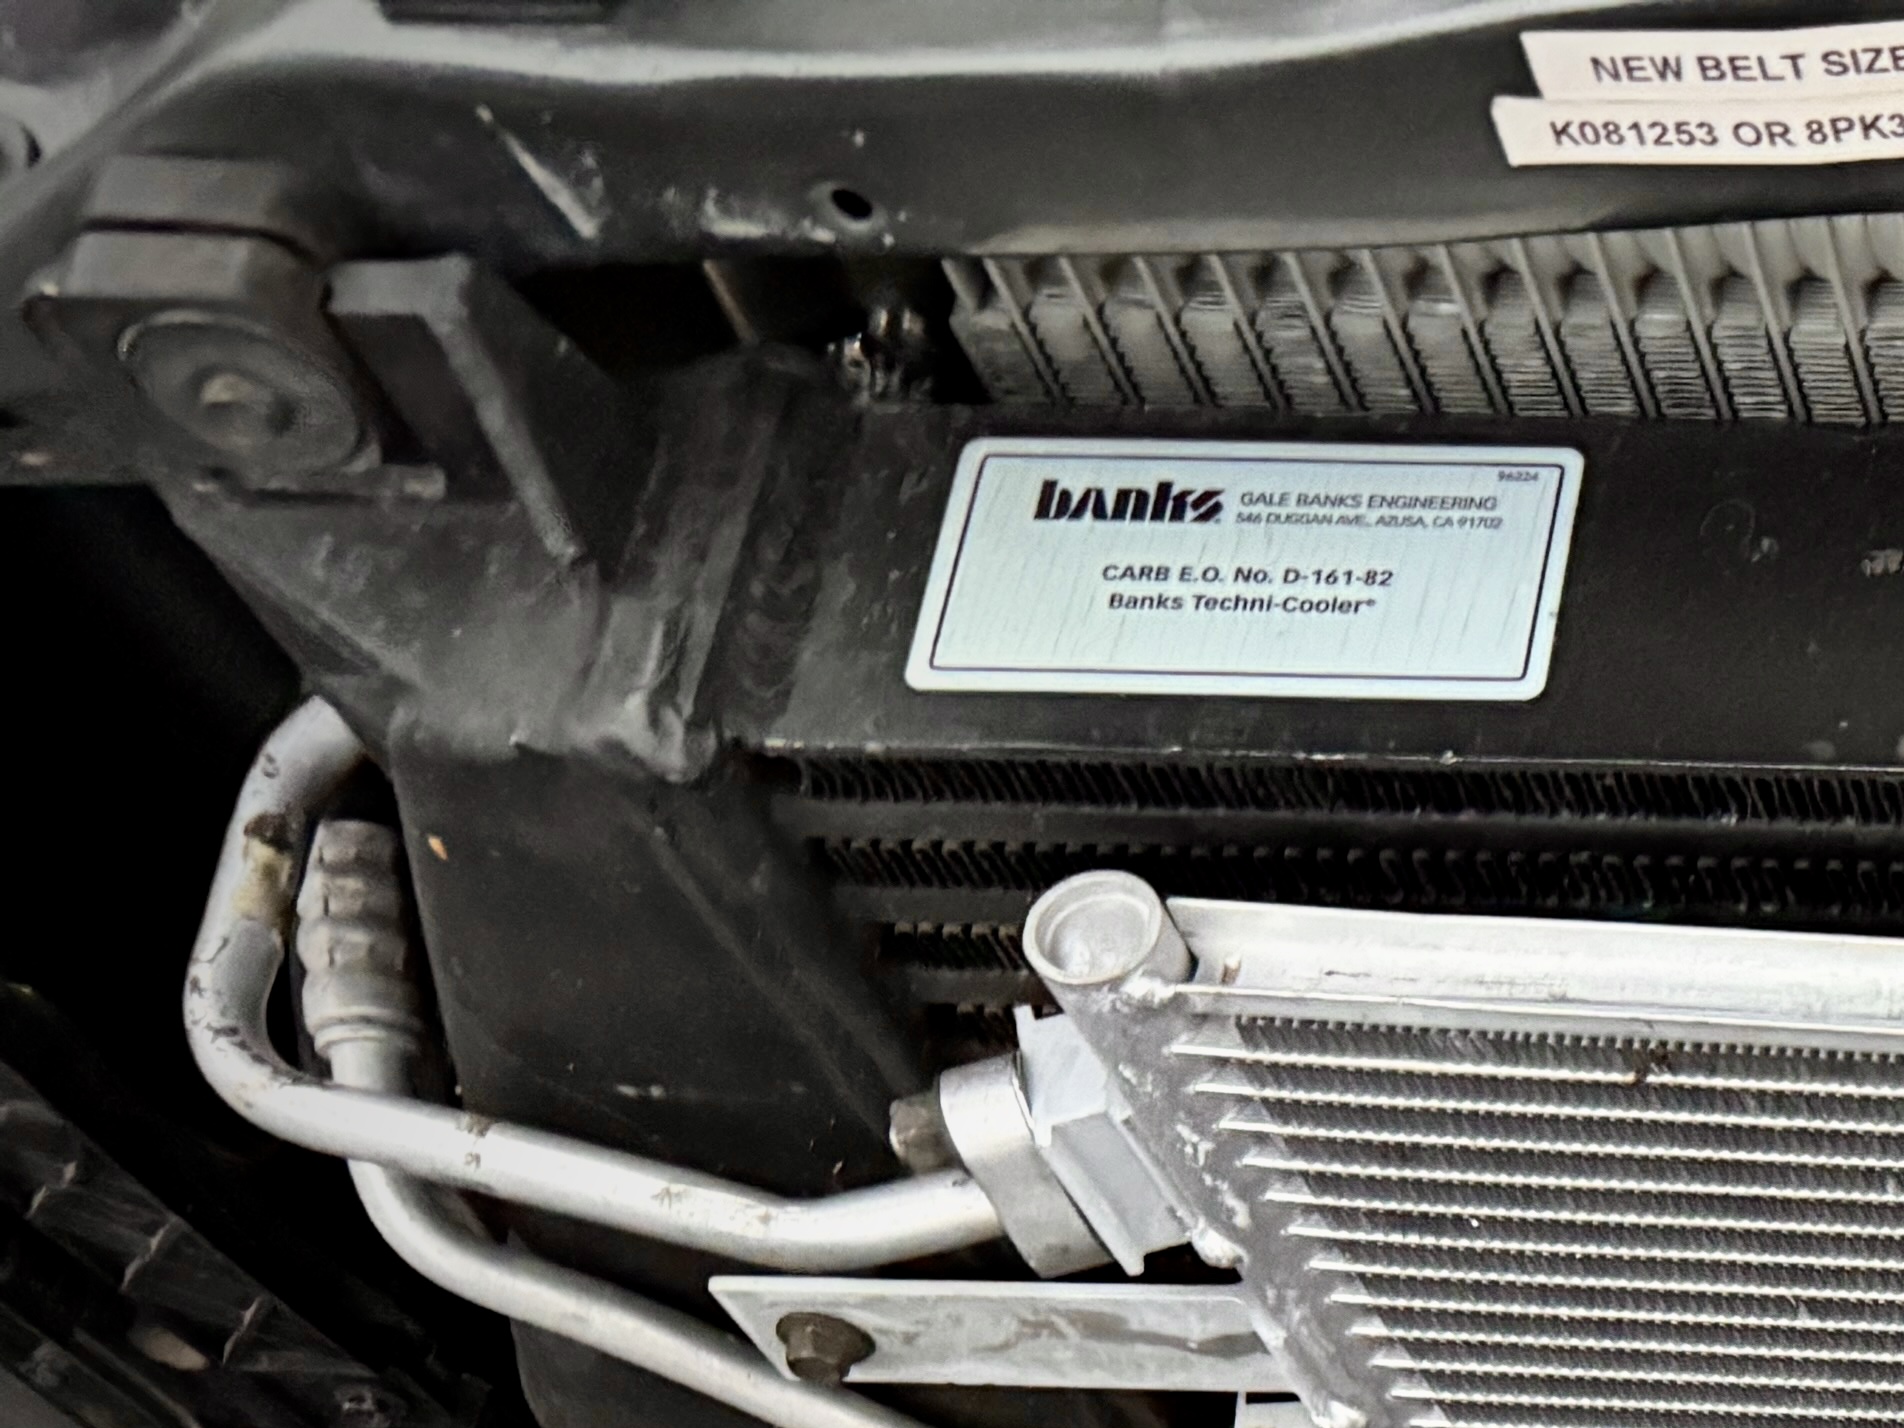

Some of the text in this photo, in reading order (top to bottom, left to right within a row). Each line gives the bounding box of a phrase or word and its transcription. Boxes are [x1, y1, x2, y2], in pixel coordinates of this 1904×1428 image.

[1590, 54, 1684, 83] NEW
[1699, 52, 1805, 82] BELT
[1550, 119, 1718, 148] K081253
[1732, 120, 1798, 148] OR
[1239, 491, 1498, 511] GALE BANKS ENGINEERING
[1433, 516, 1454, 528] CA
[1102, 564, 1394, 587] CARB E.O. No. D-161-82
[1108, 592, 1184, 611] Banks
